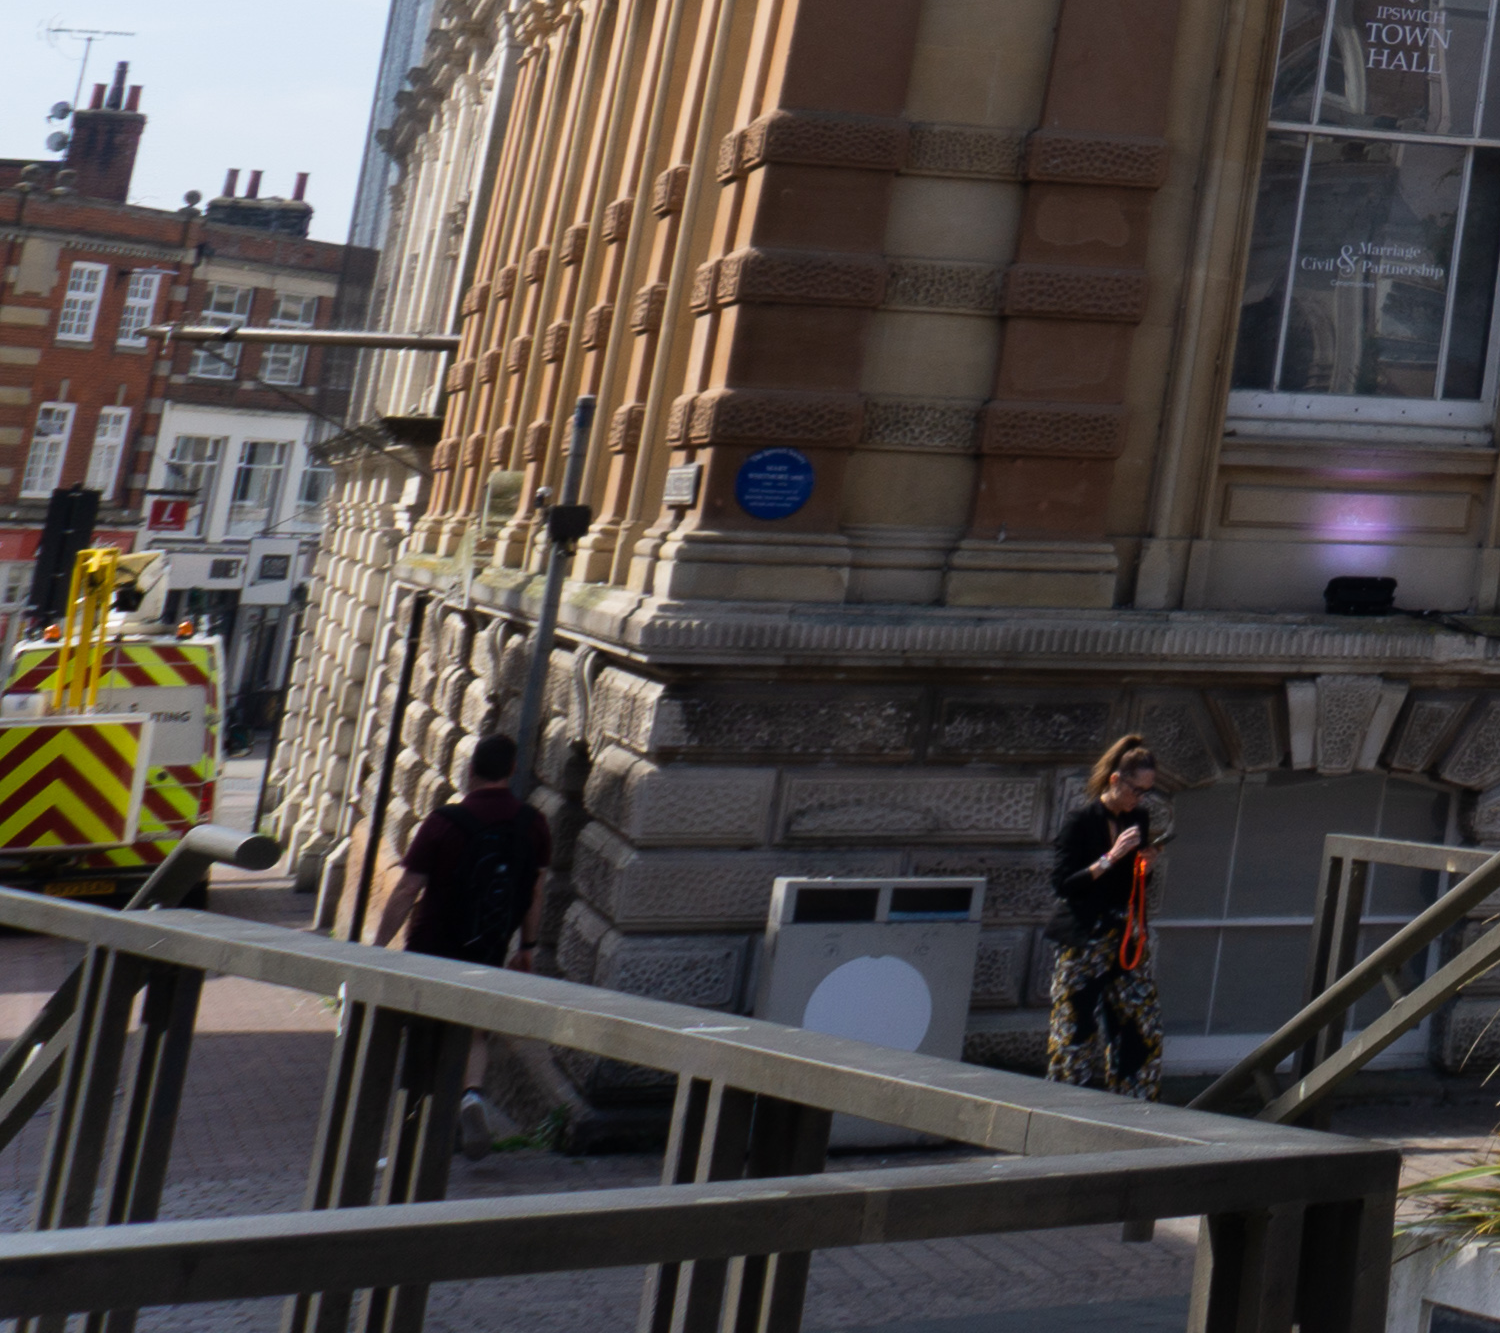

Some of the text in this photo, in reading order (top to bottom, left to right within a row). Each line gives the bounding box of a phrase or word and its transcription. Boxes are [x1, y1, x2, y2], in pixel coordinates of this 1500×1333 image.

[1376, 5, 1446, 24] IPSWICH
[1365, 22, 1453, 49] TOWN
[1365, 47, 1442, 74] HALL
[1301, 244, 1444, 280] Civil & Partnership
[1358, 241, 1421, 259] Marriage
